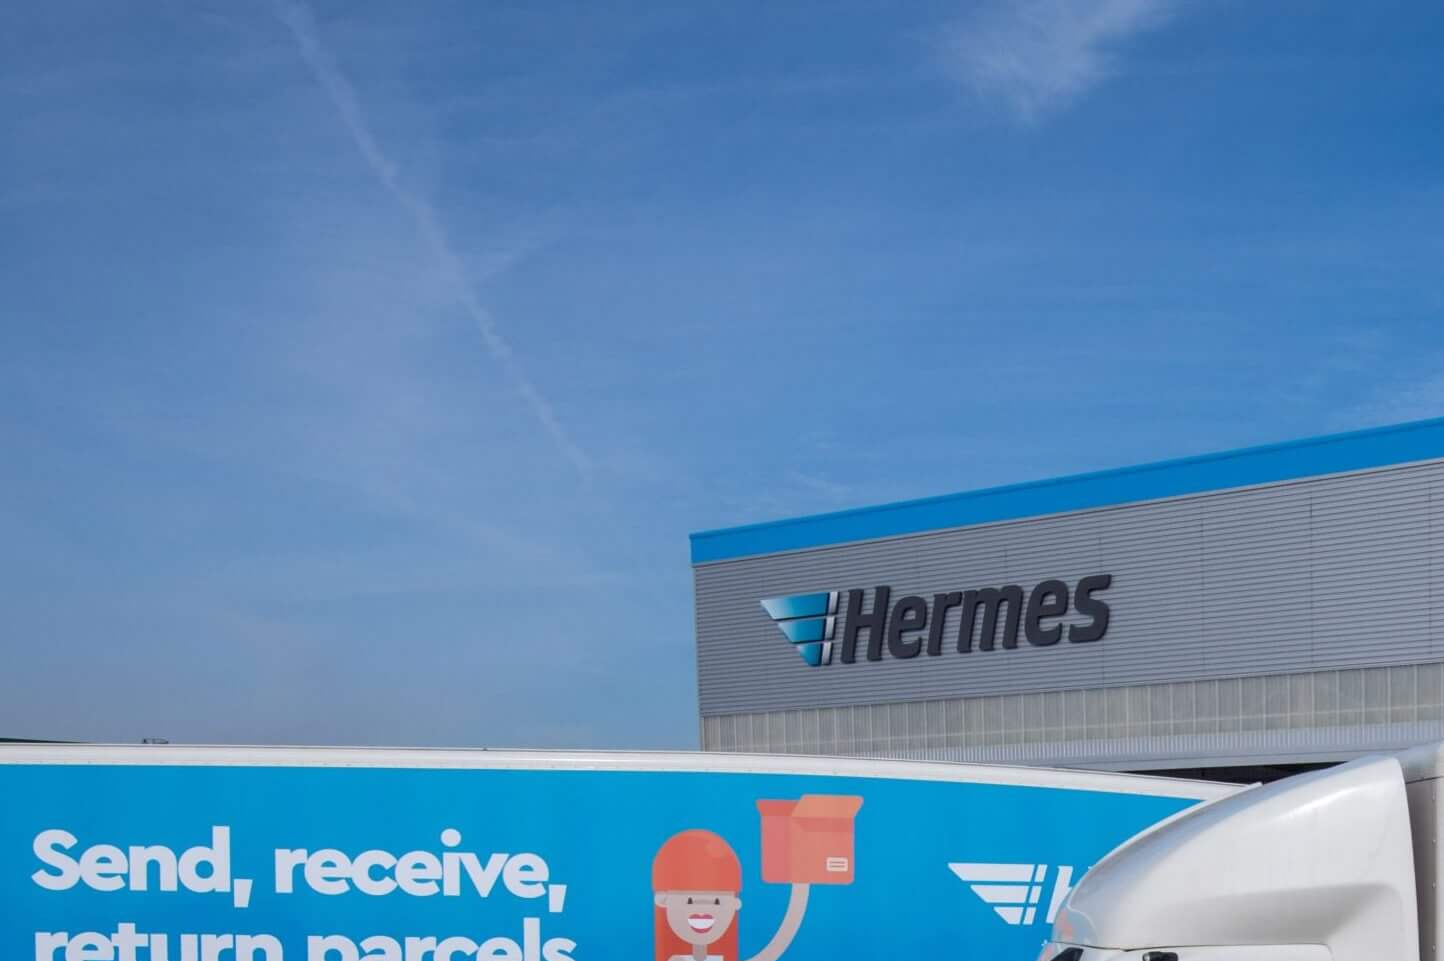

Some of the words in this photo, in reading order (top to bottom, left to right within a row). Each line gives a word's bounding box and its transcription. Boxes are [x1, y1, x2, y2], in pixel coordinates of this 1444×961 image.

[840, 573, 1112, 664] Hermes
[32, 826, 252, 907] Send,
[275, 829, 566, 912] receive,
